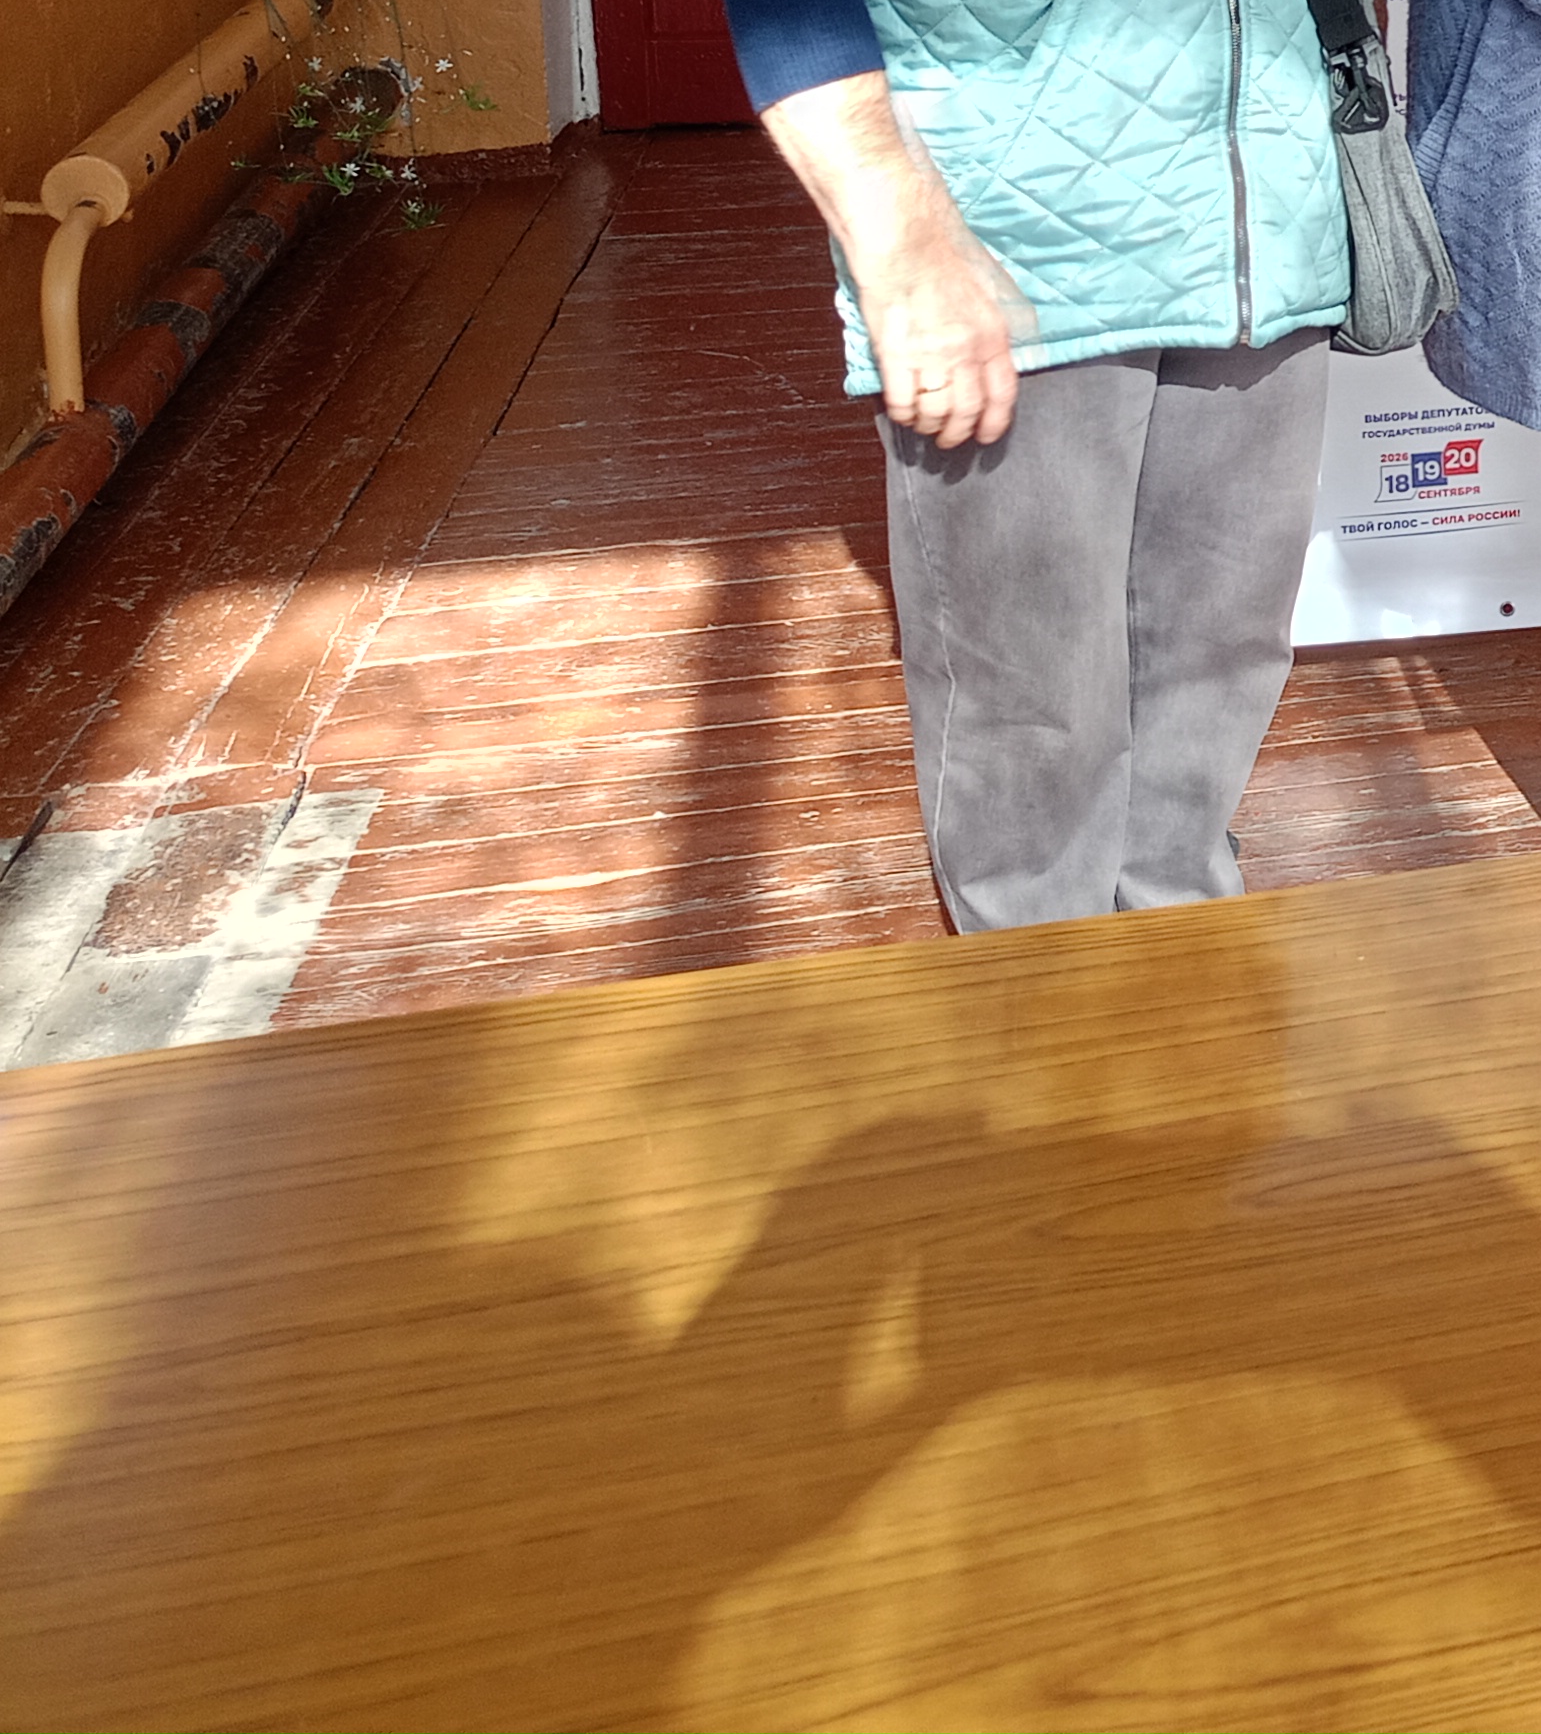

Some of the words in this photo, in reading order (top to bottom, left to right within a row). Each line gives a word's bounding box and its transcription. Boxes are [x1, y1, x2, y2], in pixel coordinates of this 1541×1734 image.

[1364, 412, 1418, 424] ВЫБОРЫ
[1362, 423, 1462, 439] ГОСУДАРСТВЕННОЙ
[1464, 421, 1495, 432] ДУМЫ
[1380, 453, 1408, 463] 2026
[1445, 447, 1477, 469] 20
[1414, 461, 1440, 482] 19
[1385, 474, 1410, 494] 18
[1418, 486, 1480, 499] СЕНТЯБРЯ
[1341, 521, 1375, 534] ТВОЙ
[1377, 519, 1418, 531] ГОЛОС
[1432, 514, 1464, 526] СИЛА
[1468, 509, 1521, 522] РОССИИ!
